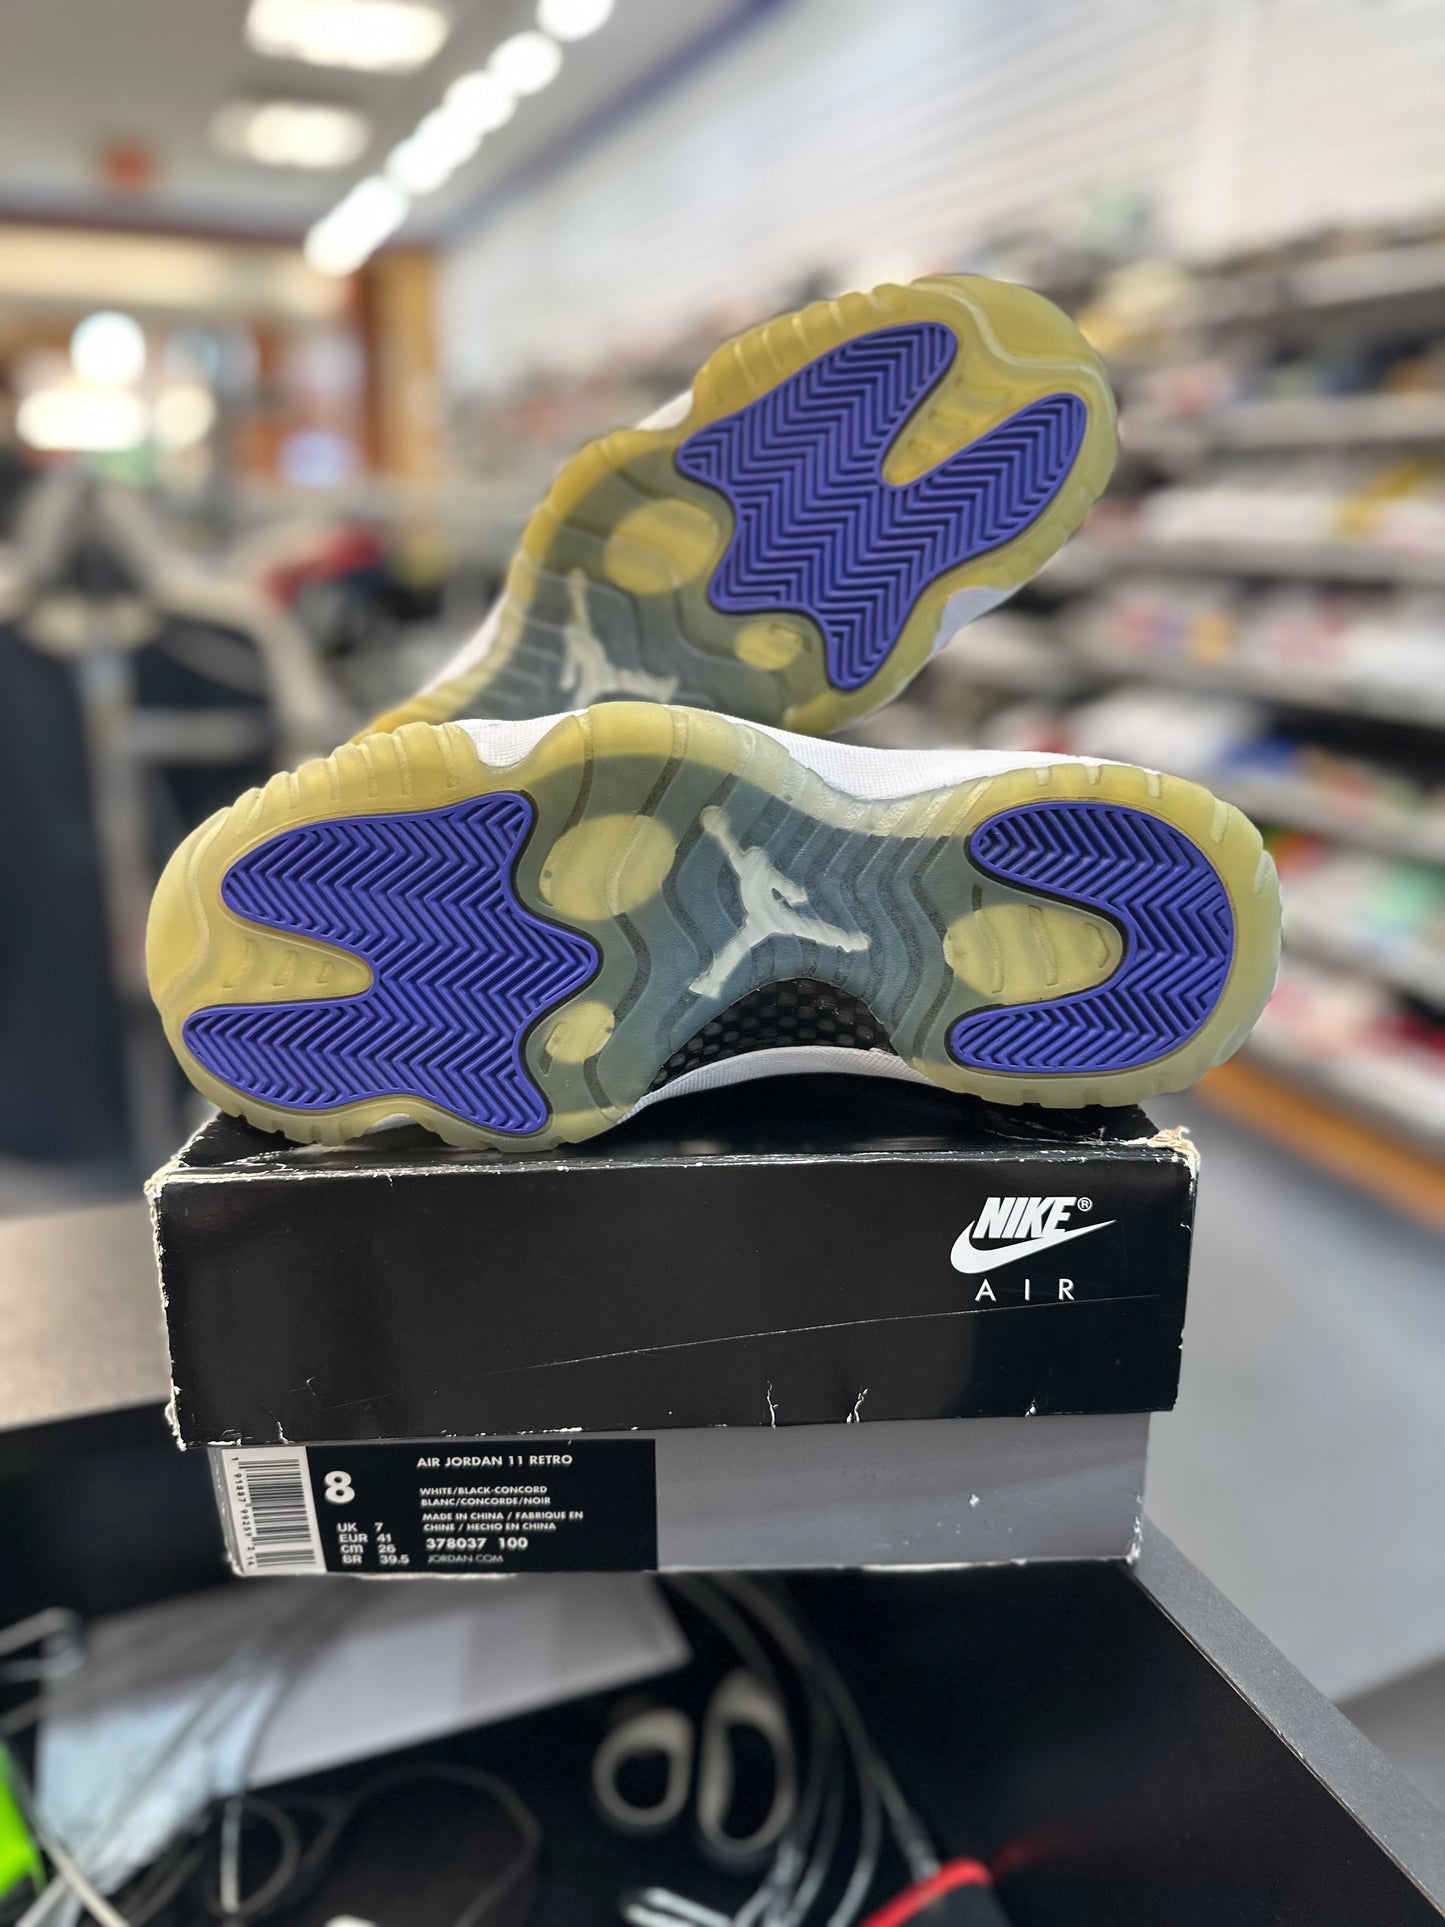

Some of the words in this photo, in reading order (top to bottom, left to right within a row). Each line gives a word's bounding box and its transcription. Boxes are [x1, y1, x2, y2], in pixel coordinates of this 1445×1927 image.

[974, 1278, 1076, 1302] AIR
[416, 1457, 440, 1468] AIR
[444, 1456, 503, 1467] JORDAN
[509, 1455, 523, 1466] 11
[529, 1454, 573, 1465] RETRO
[324, 1469, 356, 1504] 8
[420, 1485, 548, 1496] WHITE/BLACK-CONCORD
[420, 1496, 551, 1507] BLANC/CONCORDE/NOIR
[422, 1512, 452, 1522] MADE
[456, 1512, 468, 1521] IN
[470, 1511, 504, 1521] CHINA
[515, 1510, 566, 1520] FABRIQUE
[569, 1510, 583, 1520] EN
[336, 1521, 358, 1533] UK
[374, 1521, 384, 1533] 7
[423, 1523, 455, 1532] CHINE
[466, 1522, 503, 1532] HECHO
[505, 1522, 520, 1531] EN
[522, 1522, 557, 1531] CHINA
[338, 1533, 369, 1544] EUR
[376, 1533, 392, 1543] 41
[425, 1537, 487, 1550] 378037
[498, 1536, 529, 1549] 100
[378, 1543, 396, 1554] 26
[342, 1554, 363, 1565] BR
[379, 1554, 411, 1565] 39.5
